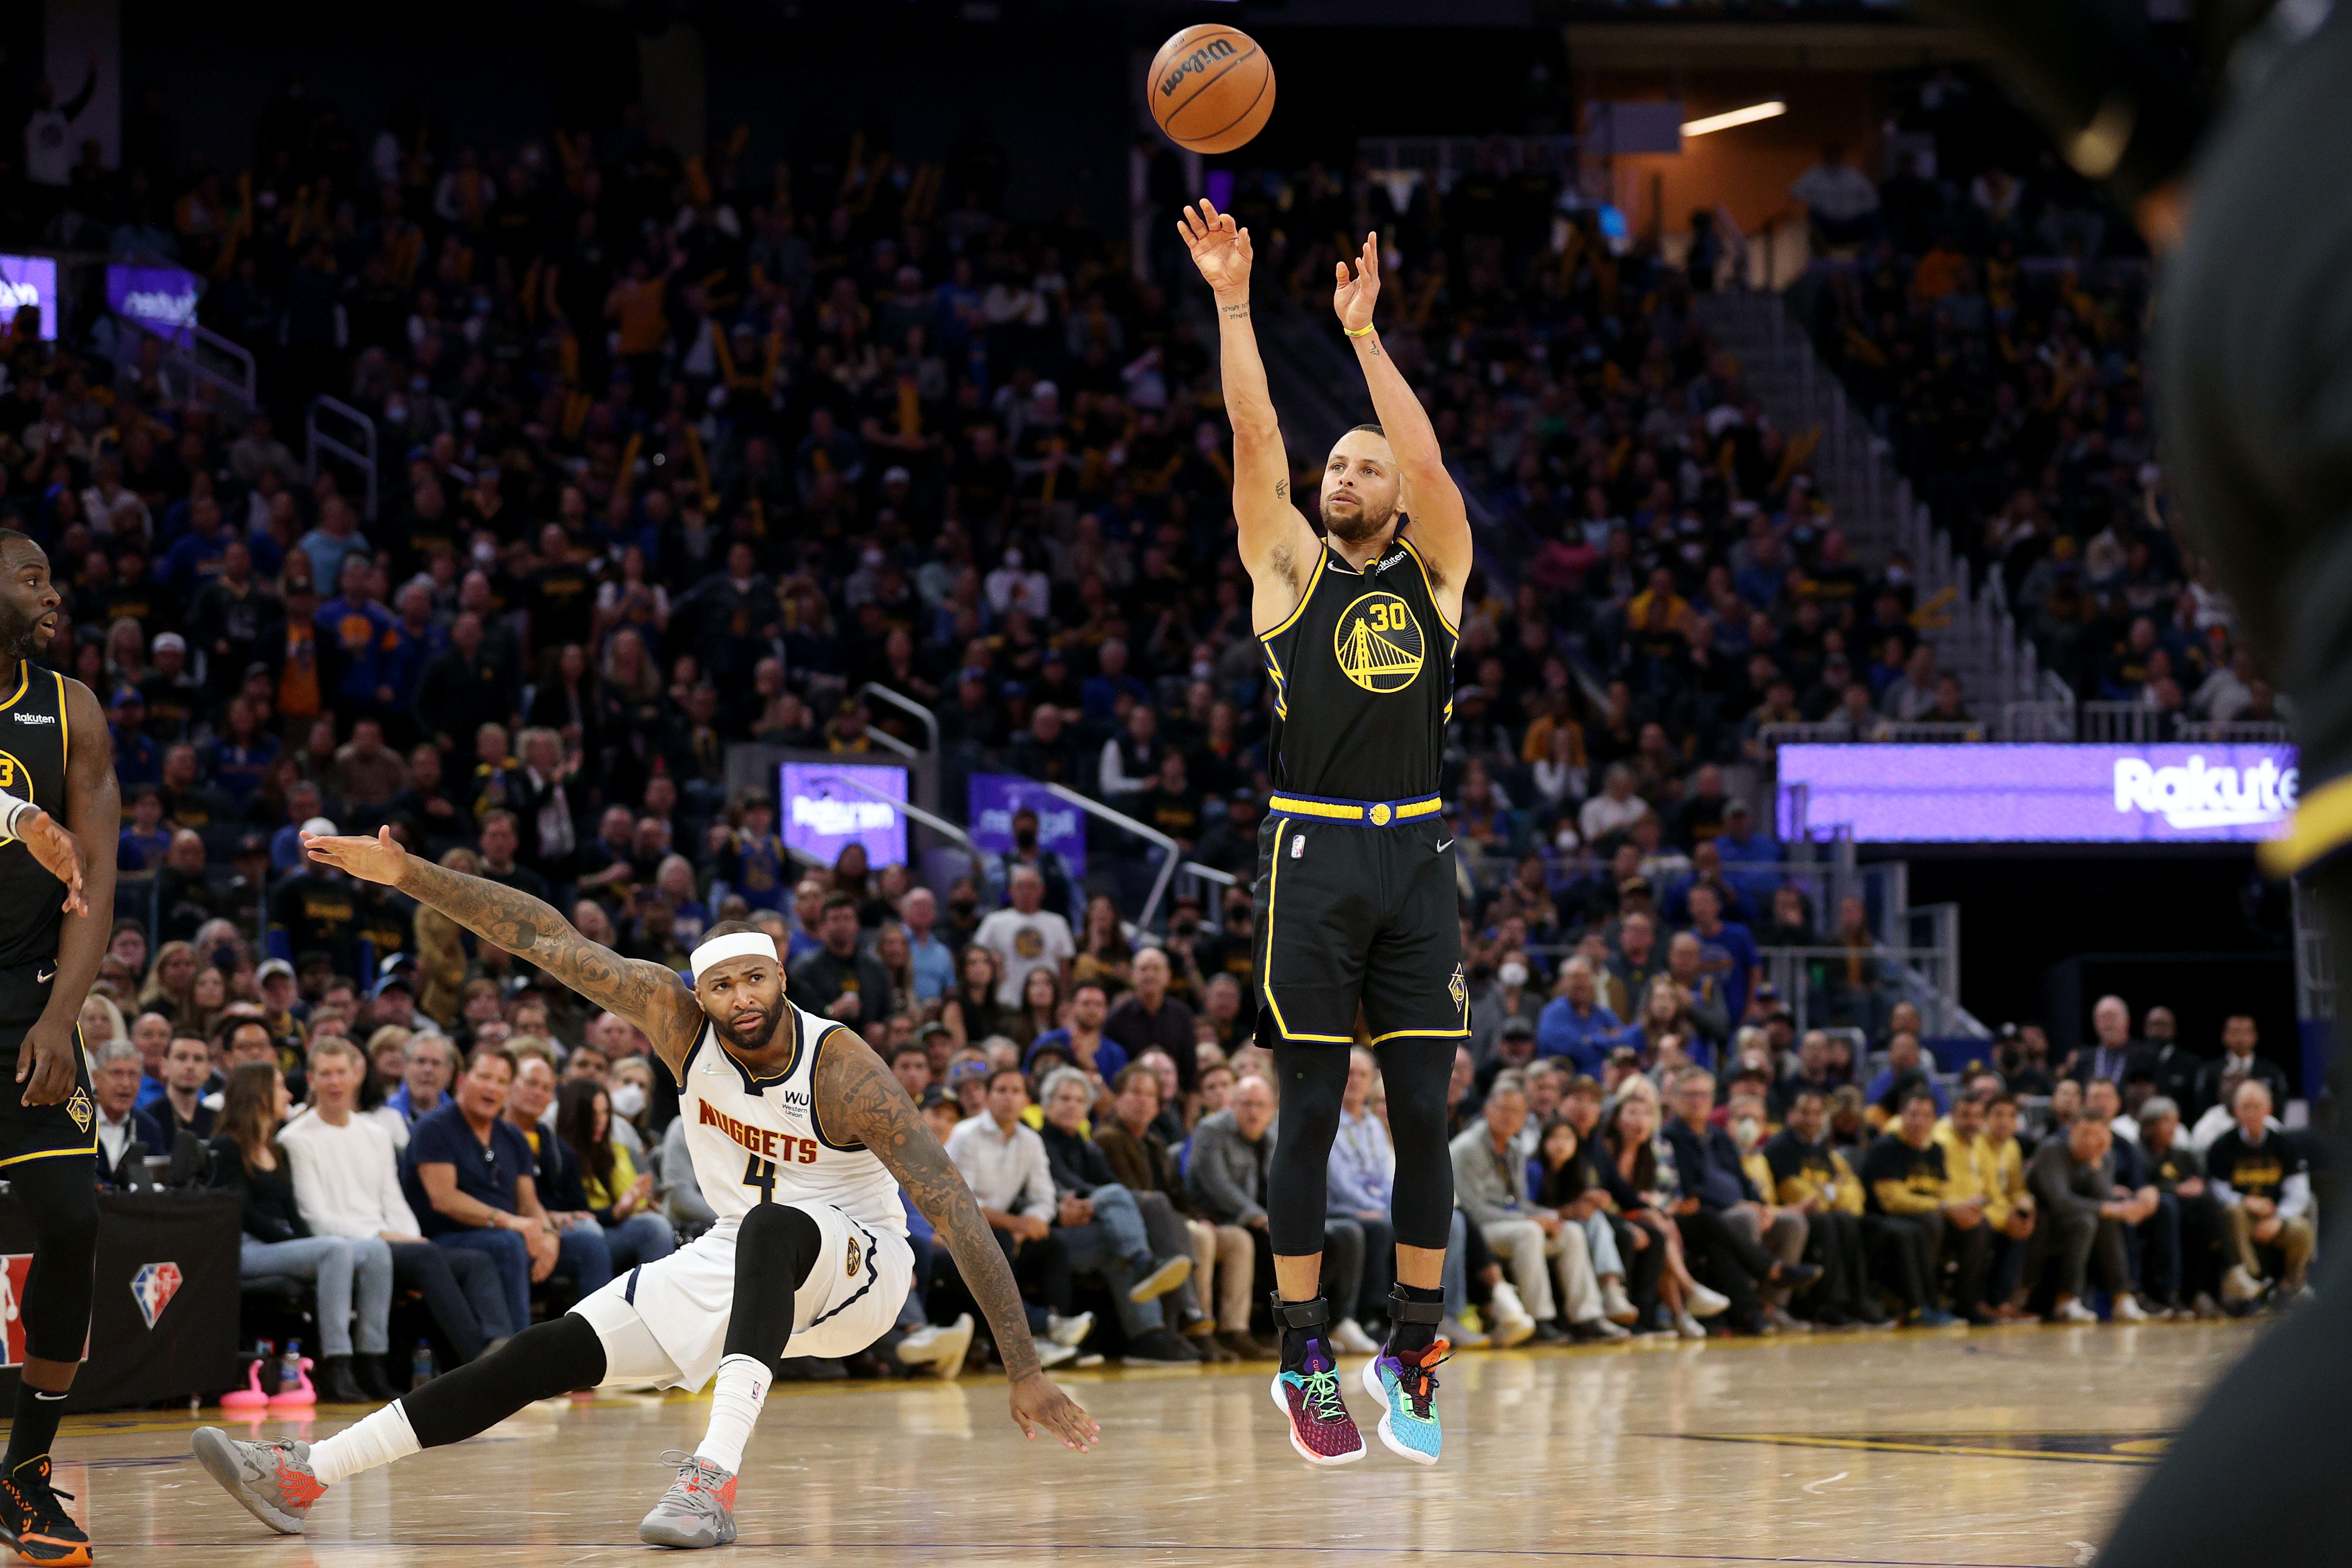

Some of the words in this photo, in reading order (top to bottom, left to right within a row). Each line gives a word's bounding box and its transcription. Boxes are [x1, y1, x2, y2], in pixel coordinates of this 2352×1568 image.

[1161, 39, 1238, 96] Wilson
[1369, 602, 1407, 632] 30
[14, 712, 55, 724] Rakuten
[782, 1103, 807, 1113] Western
[785, 1091, 809, 1106] WU
[785, 1109, 803, 1118] Union
[699, 1097, 817, 1164] NUGGETS
[741, 1152, 777, 1204] 4
